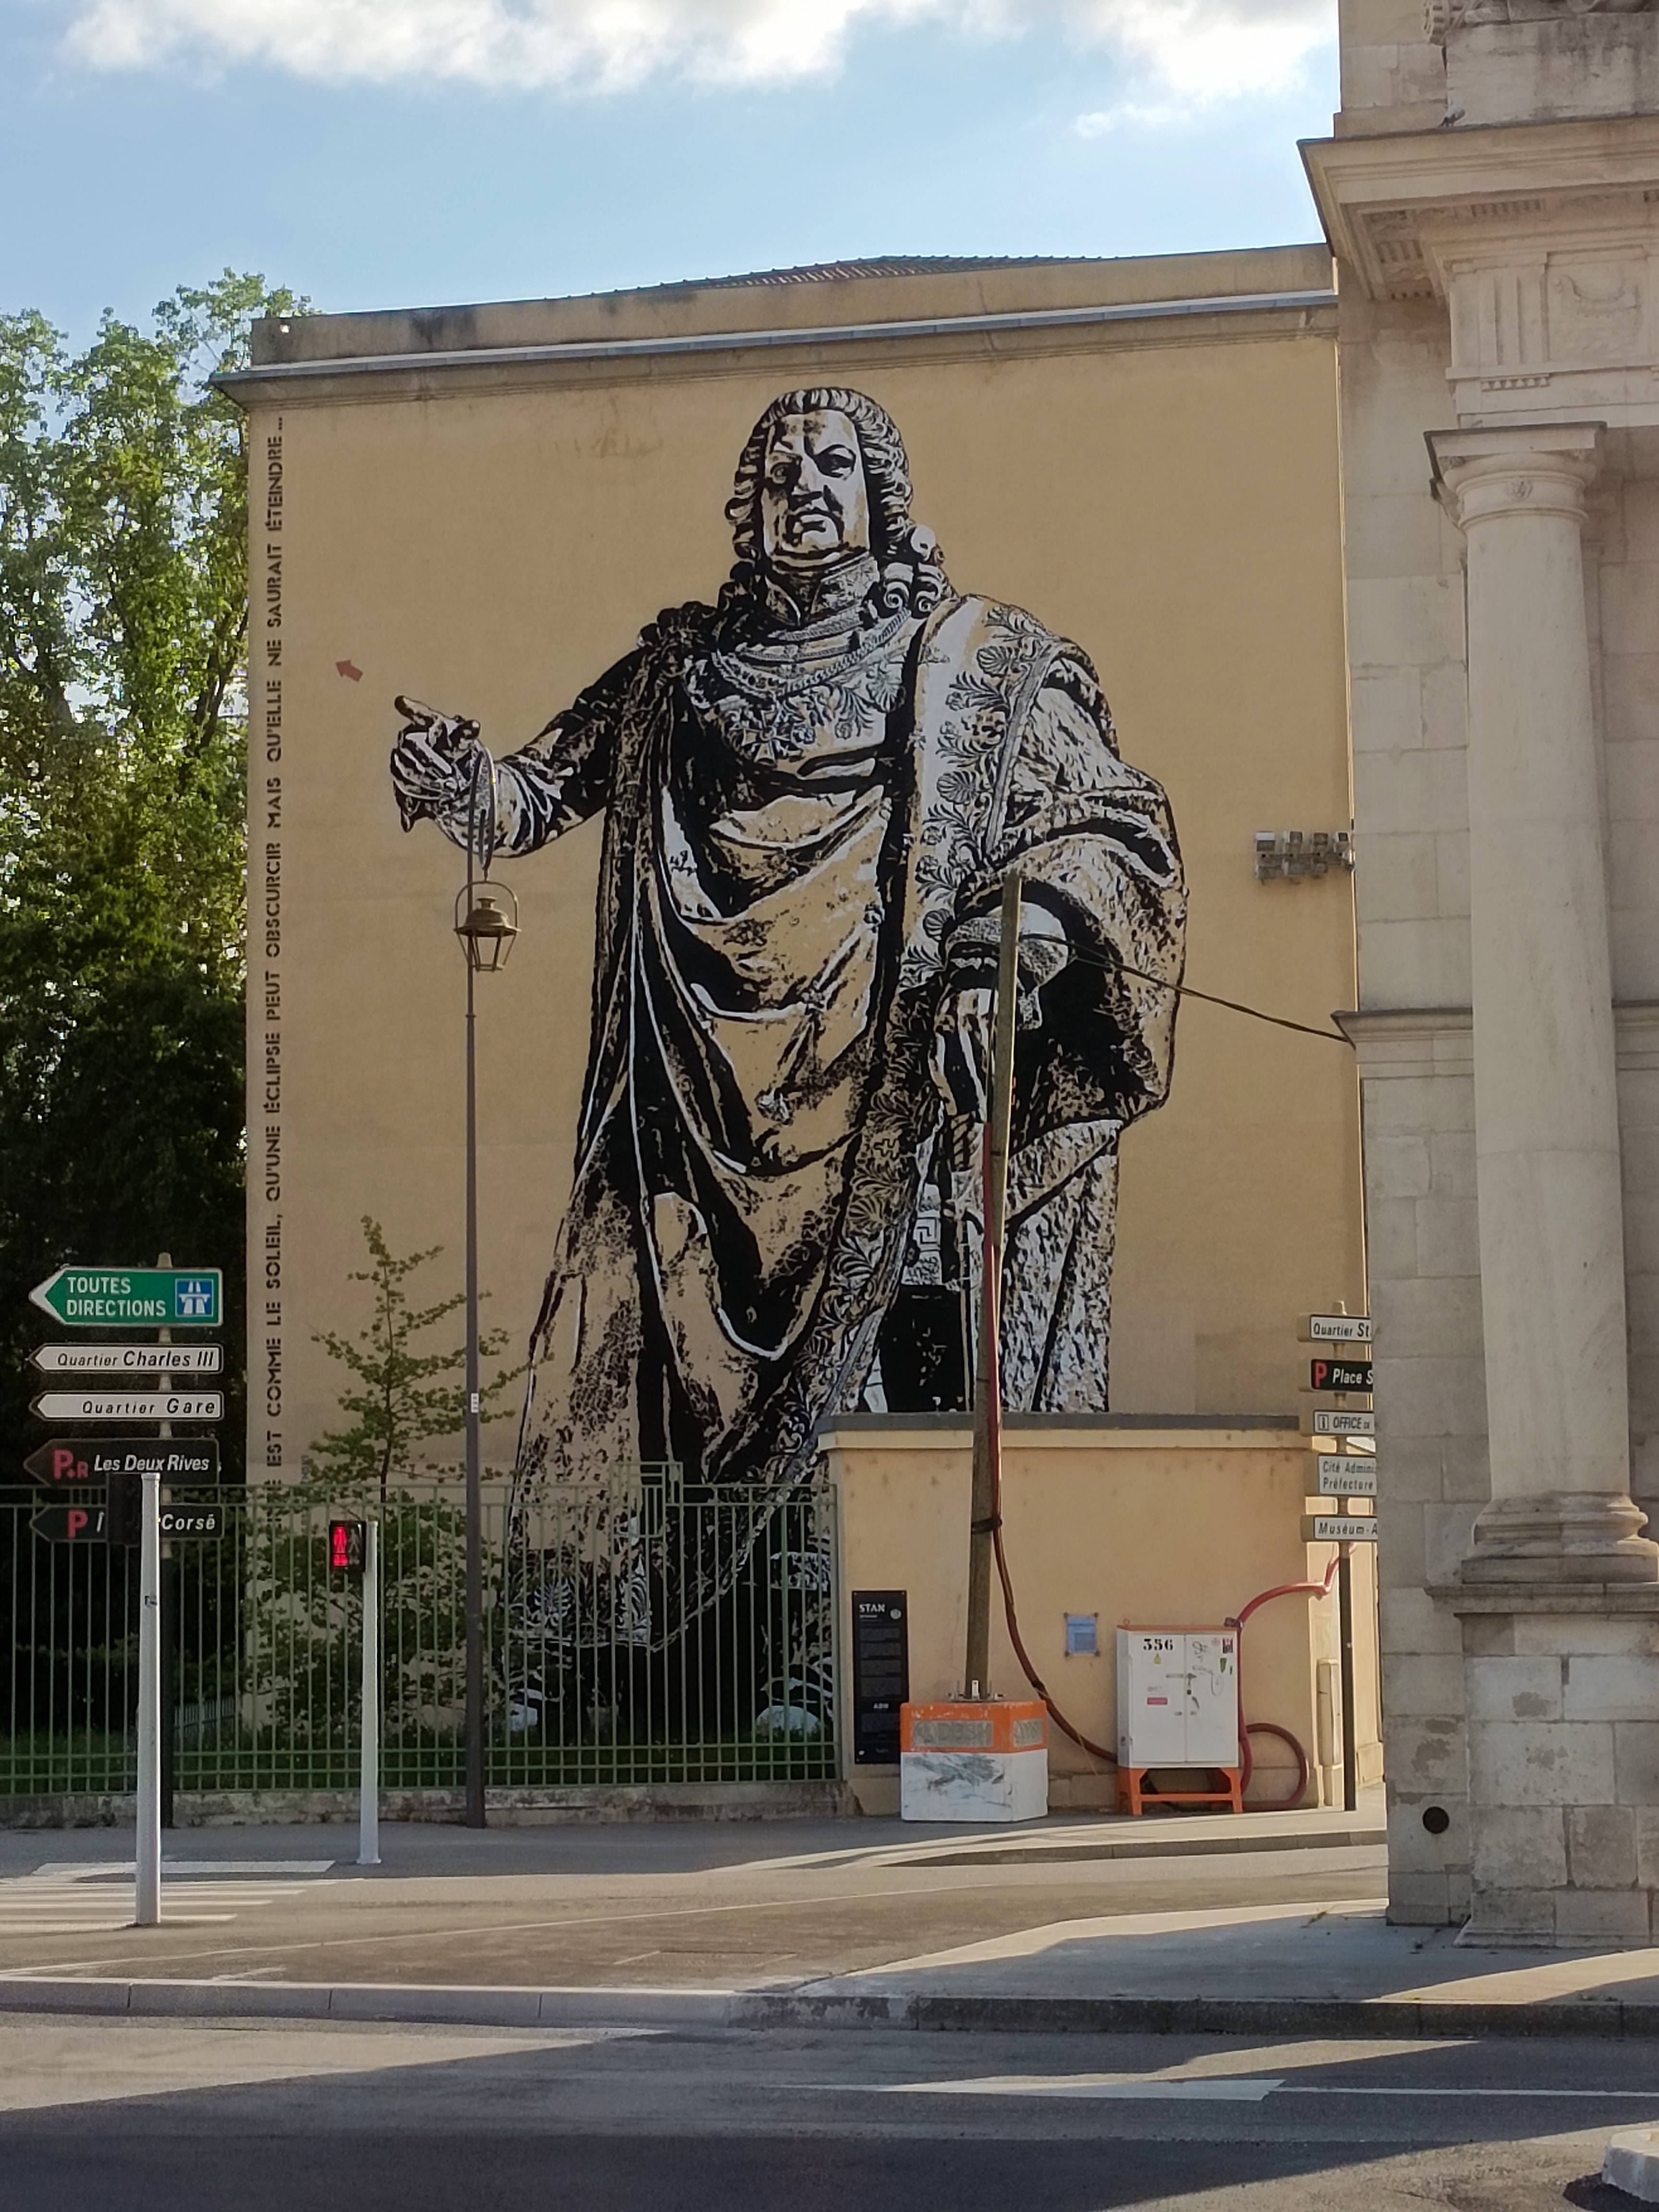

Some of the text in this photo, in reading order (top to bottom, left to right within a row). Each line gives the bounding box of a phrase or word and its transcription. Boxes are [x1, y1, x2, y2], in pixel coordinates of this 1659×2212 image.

[266, 543, 282, 628] SAURAIT
[266, 639, 282, 666] NE
[266, 680, 282, 762] QU'ELLE
[267, 777, 282, 829] MAIS
[266, 842, 282, 958] OBSCURCIR
[265, 970, 281, 1021] PEUT
[263, 1033, 281, 1113] ÉCLIPSE
[265, 1126, 281, 1202] QU'UNE
[265, 1214, 283, 1289] SOLEIL,
[67, 1277, 131, 1294] TOUTES
[66, 1299, 166, 1317] DIRECTIONS
[265, 1302, 281, 1326] LE
[1313, 1322, 1353, 1336] Quartier
[57, 1350, 215, 1367] Quartier Charles III
[266, 1338, 282, 1417] COMME
[1332, 1368, 1362, 1384] Place
[83, 1398, 215, 1414] Quartier Gare
[1333, 1417, 1362, 1429] OFFICE
[266, 1430, 282, 1467] EST
[94, 1454, 120, 1471] Les
[124, 1454, 165, 1471] Deux
[167, 1454, 210, 1471] Rives
[1323, 1461, 1340, 1473] Cité
[1323, 1477, 1373, 1490] Préfecture
[67, 1509, 88, 1539] P
[859, 1603, 885, 1613] STAN
[1143, 1638, 1173, 1651] 356
